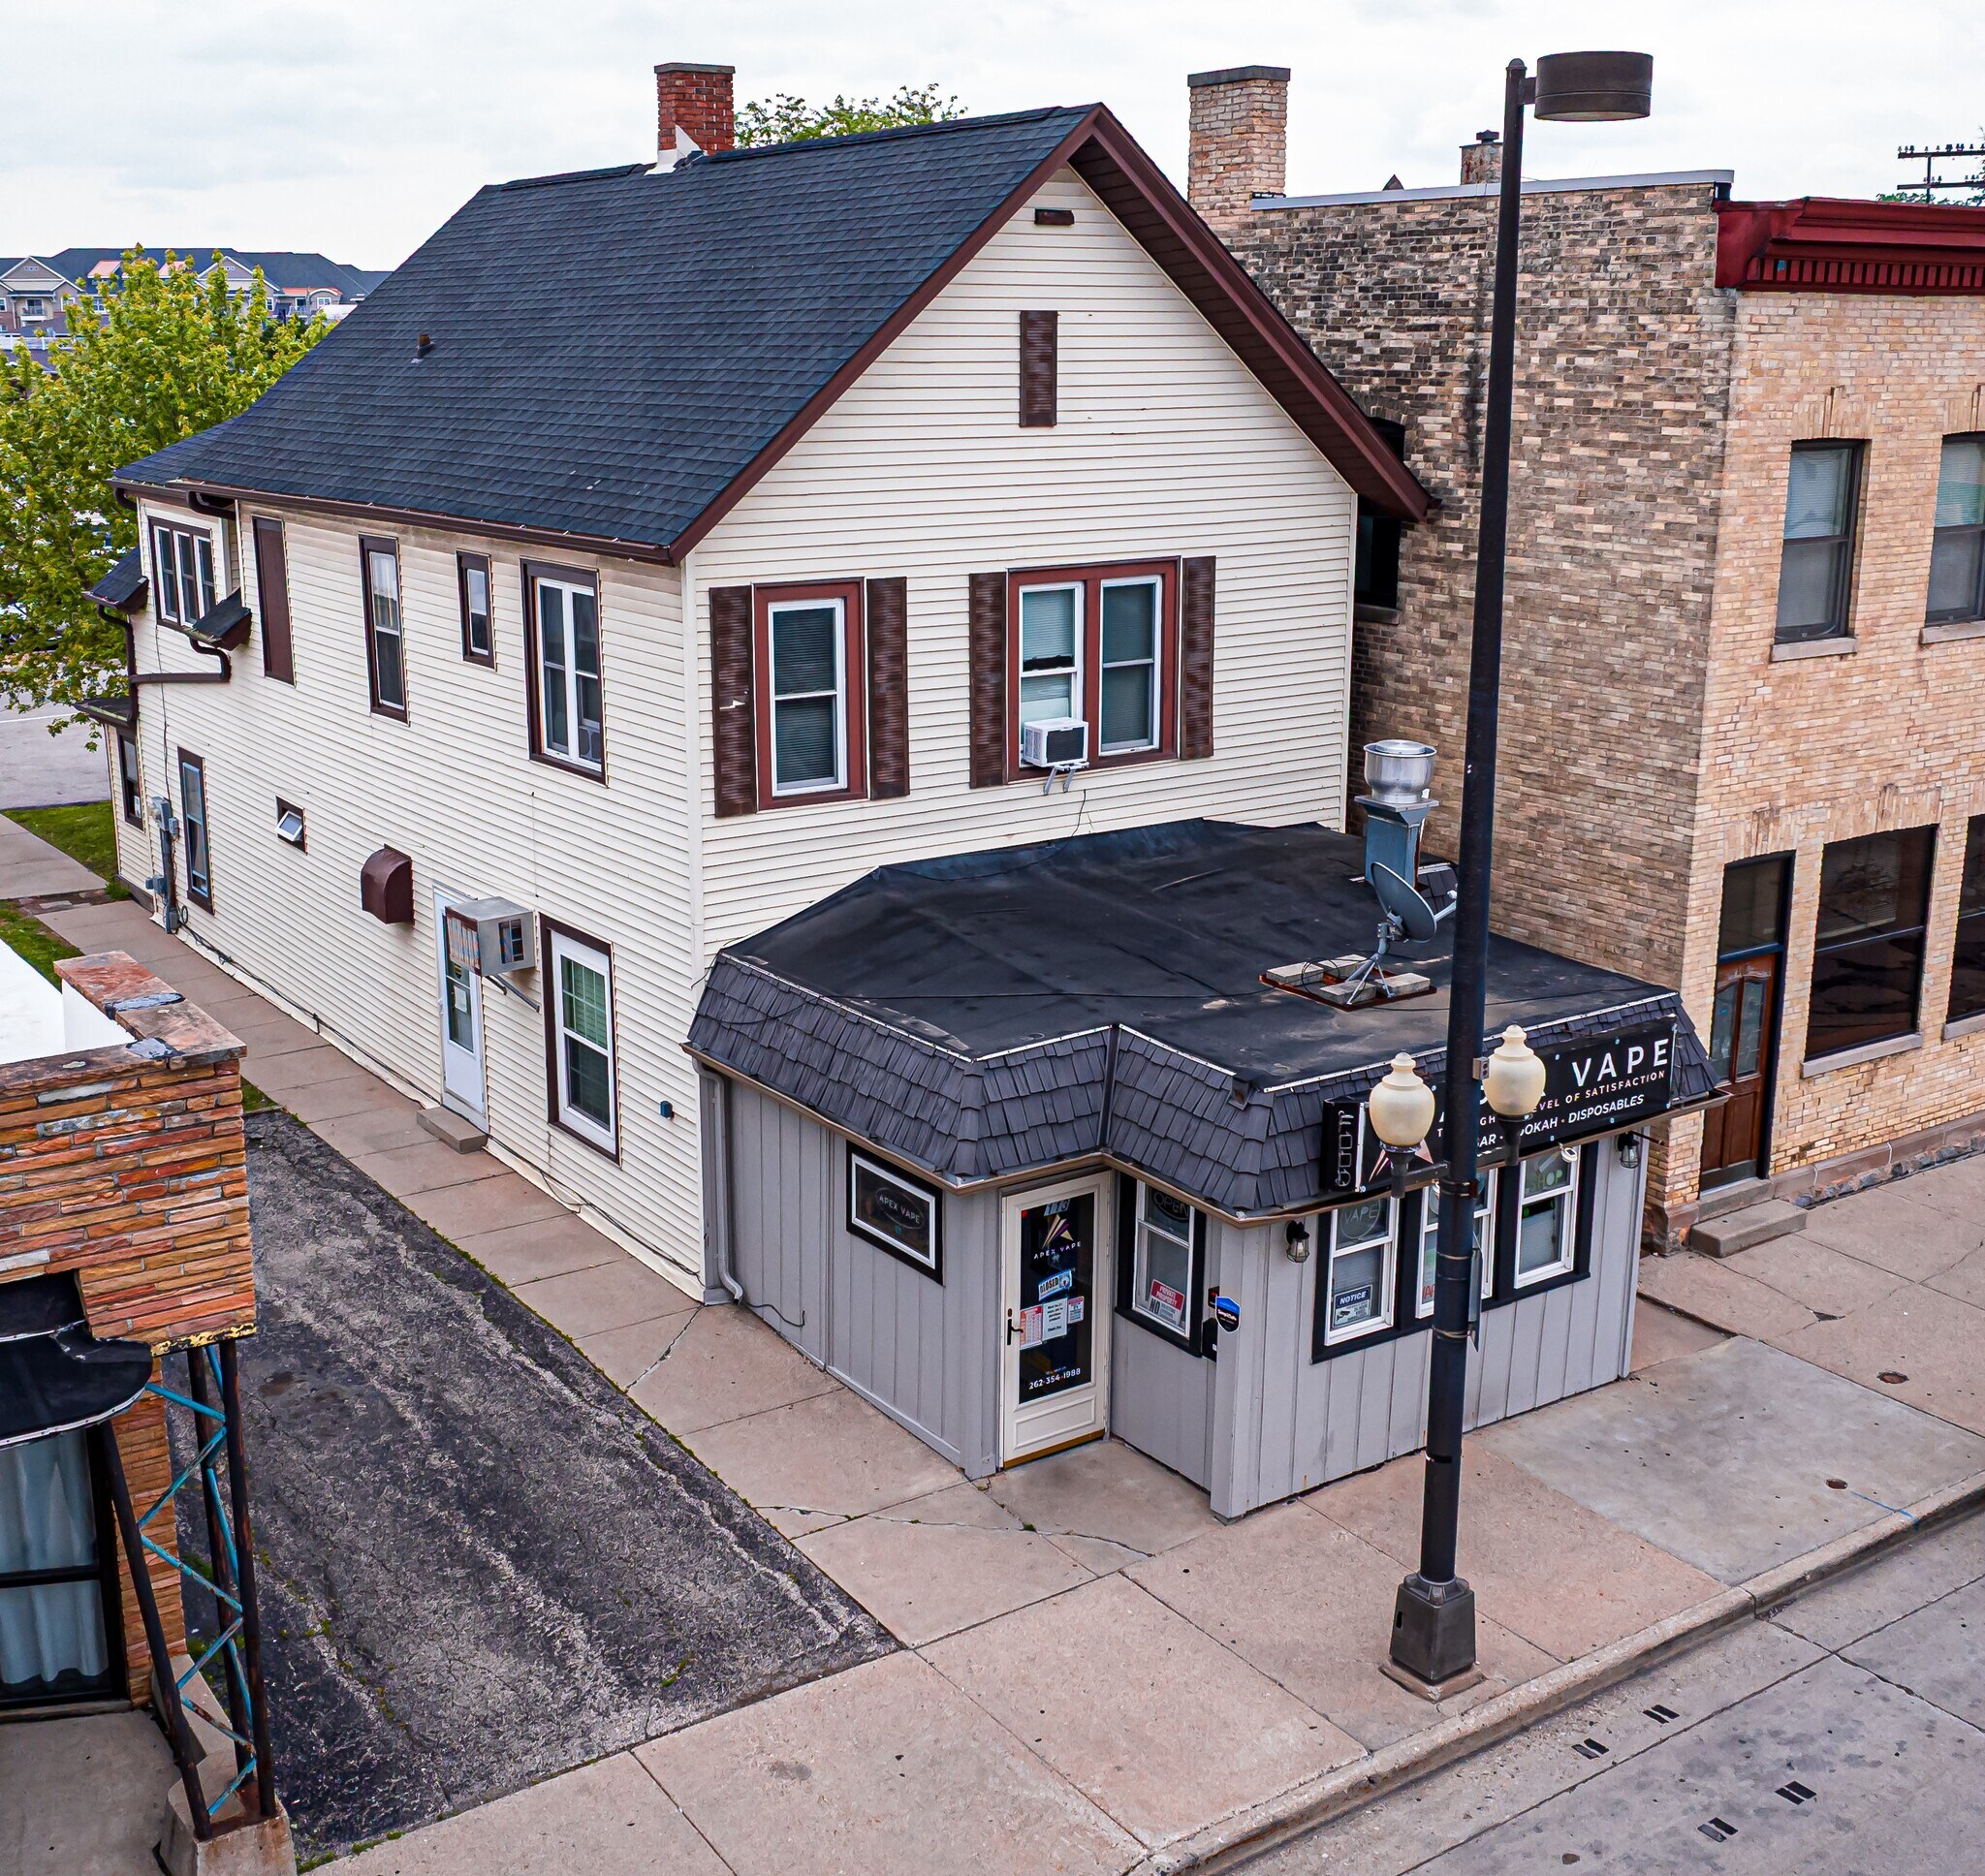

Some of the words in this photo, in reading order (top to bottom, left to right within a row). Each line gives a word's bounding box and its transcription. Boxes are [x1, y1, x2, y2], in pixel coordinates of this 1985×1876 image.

[1572, 1039, 1669, 1087] VAPE
[1531, 1098, 1560, 1113] VEL
[1565, 1092, 1581, 1104] OF
[1585, 1070, 1665, 1099] SATISFACTION
[1520, 1116, 1559, 1137] OKAH
[1567, 1094, 1645, 1124] DISPOSABLES
[879, 1194, 898, 1212] APEX
[900, 1205, 920, 1224] VAPE
[1153, 1192, 1189, 1217] OPEN
[1344, 1204, 1378, 1225] VAPE
[1033, 1249, 1056, 1260] APEX
[1059, 1241, 1082, 1252] VAPE
[1040, 1276, 1059, 1294] CLOSED
[1150, 1298, 1161, 1315] NO
[1339, 1291, 1367, 1304] NOTICE
